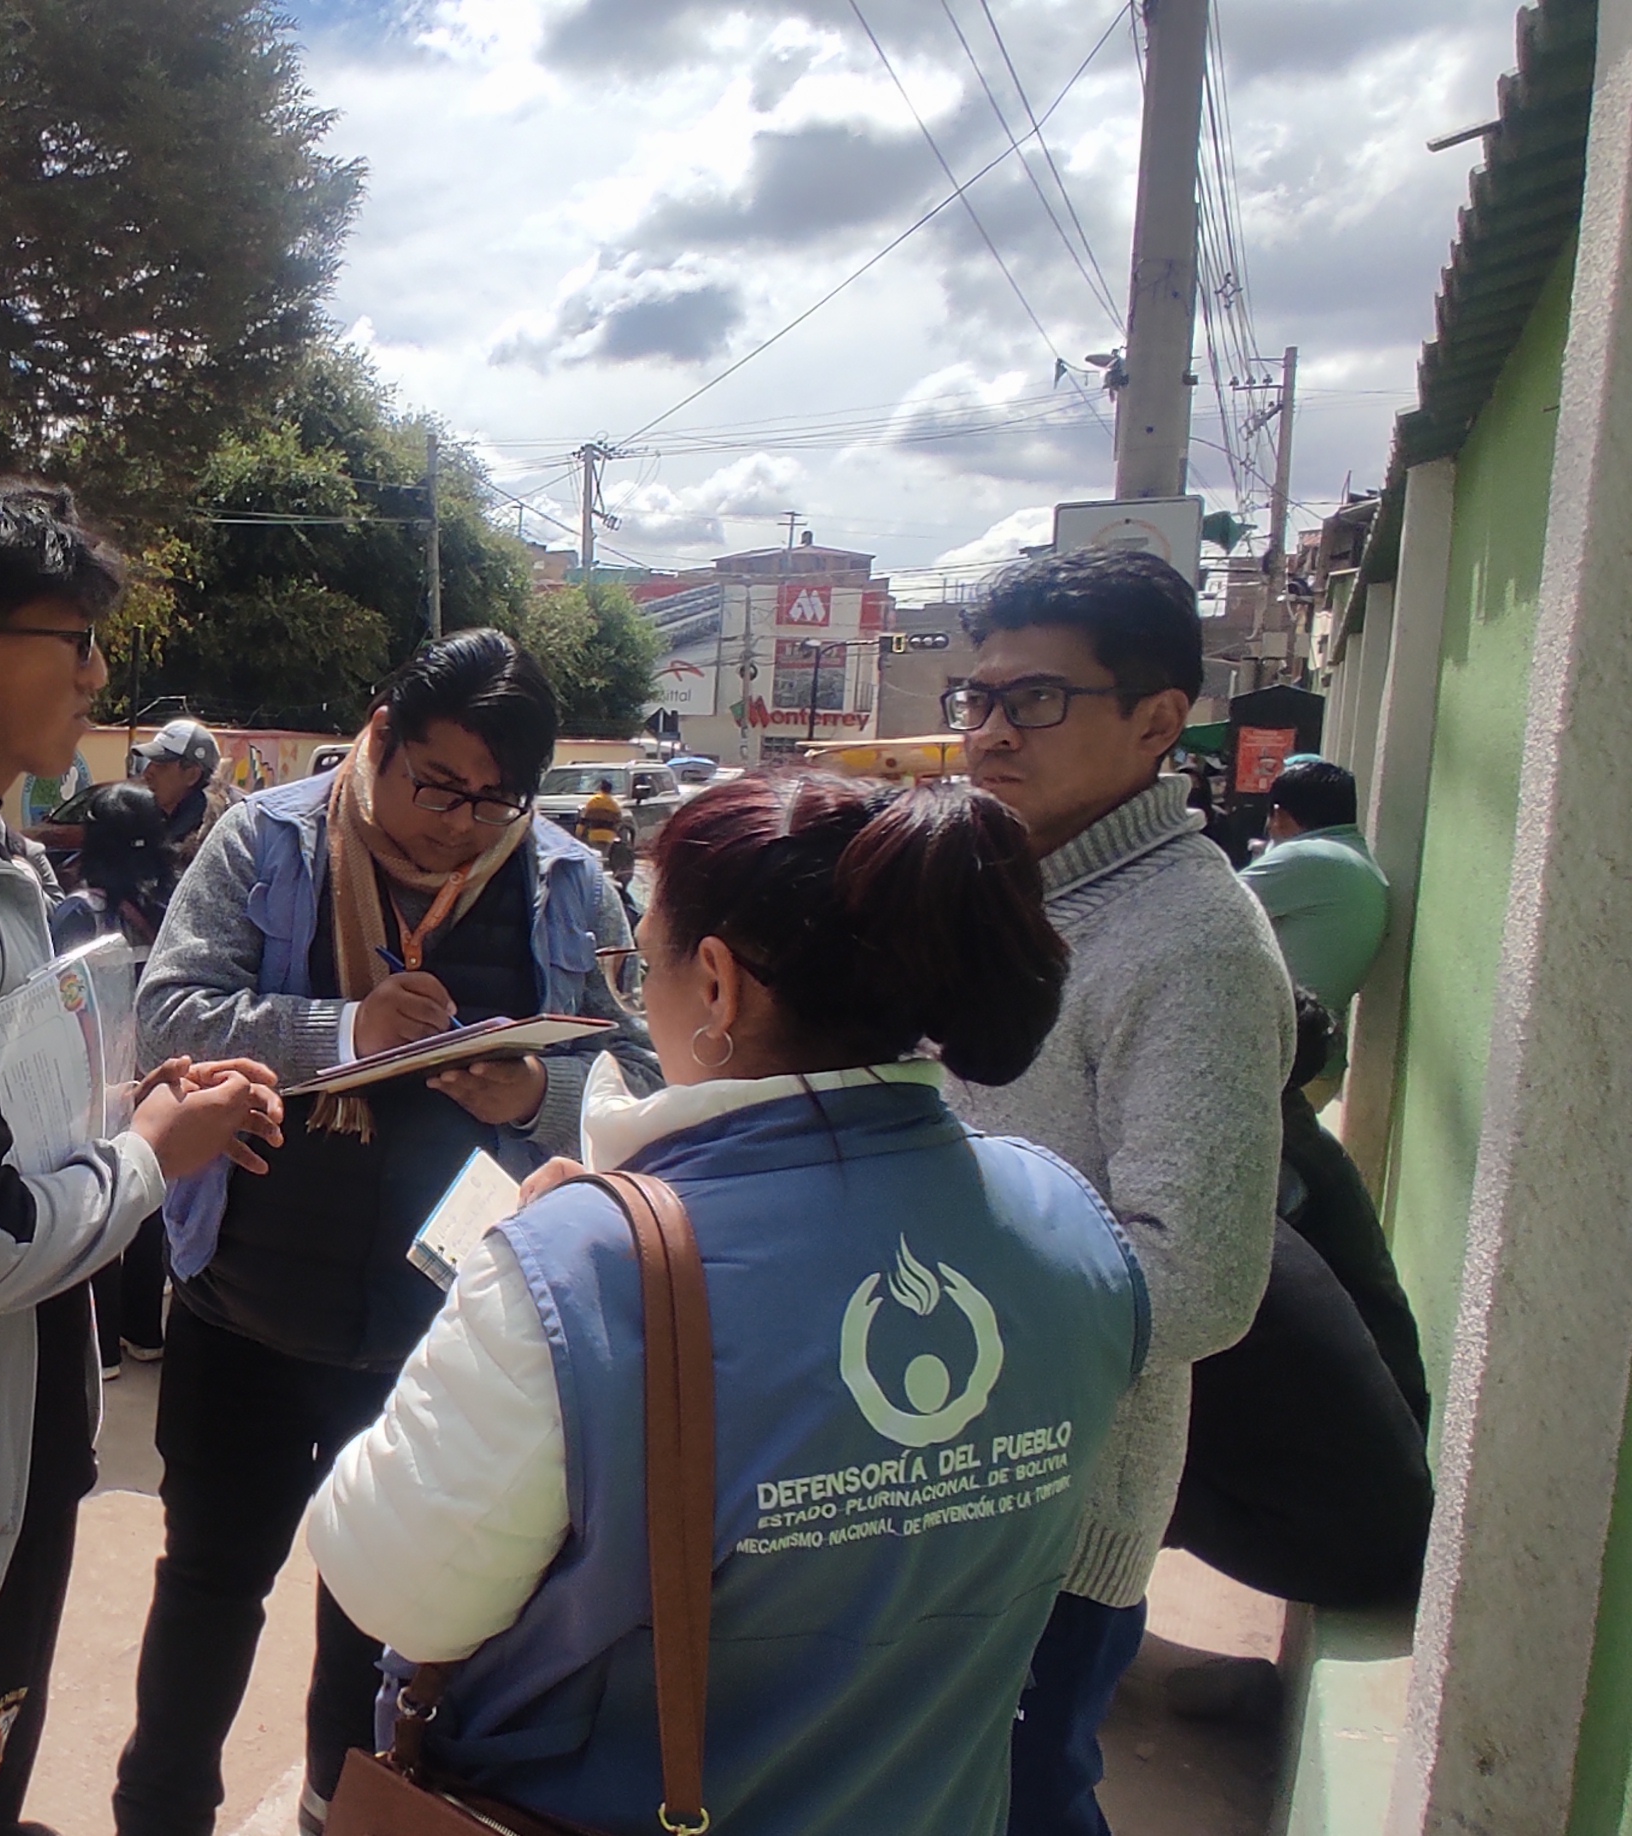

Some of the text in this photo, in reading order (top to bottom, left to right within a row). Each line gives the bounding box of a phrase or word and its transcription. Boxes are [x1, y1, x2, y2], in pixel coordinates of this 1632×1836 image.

[729, 694, 870, 731] Monterrey
[756, 1420, 1072, 1511] DEFENSORÍA DEL PUEBLO
[757, 1452, 1069, 1530] ESTADO PLURINACIONAL DE BOLIVIA
[735, 1530, 824, 1555] MECANISMO
[828, 1517, 897, 1546] NACIONAL
[903, 1517, 922, 1536] DE
[998, 1495, 1015, 1514] DE
[1016, 1491, 1032, 1509] LA
